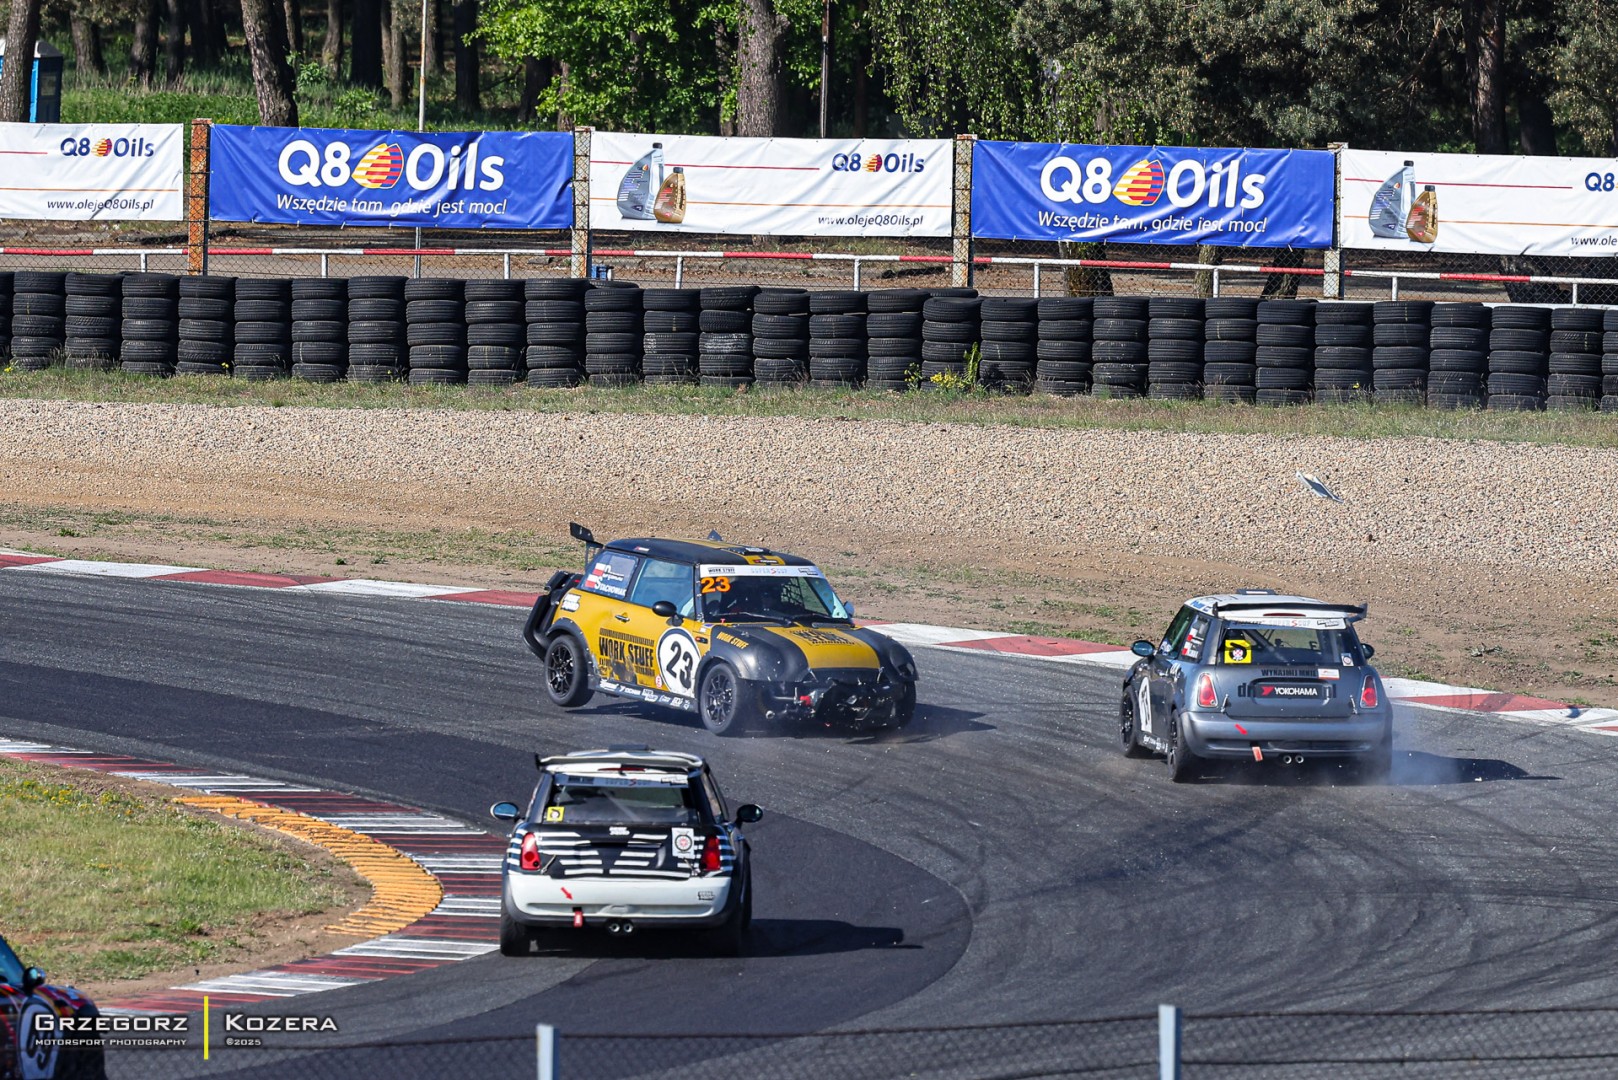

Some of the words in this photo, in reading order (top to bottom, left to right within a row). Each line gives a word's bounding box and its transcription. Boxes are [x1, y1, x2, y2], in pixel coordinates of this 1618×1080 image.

[60, 137, 90, 157] Q8
[113, 137, 155, 157] Oils
[278, 139, 351, 188] Q8
[405, 142, 505, 191] Oils
[832, 153, 862, 172] Q8
[883, 152, 925, 173] Oils
[1039, 156, 1113, 205] Q8
[1166, 159, 1267, 209] Oils
[1584, 172, 1615, 192] Q8
[47, 199, 154, 212] www.olejeQ8Oils.pl
[276, 193, 347, 214] Wszędzie
[351, 198, 387, 214] tam,
[390, 200, 432, 217] gdzie
[433, 198, 464, 217] jest
[468, 199, 507, 214] moc!
[818, 214, 924, 228] www.olejeQ8Oils.pl
[1038, 210, 1109, 231] Wszędzie
[1113, 214, 1148, 233] tam,
[1152, 215, 1193, 233] gdzie
[1197, 216, 1224, 233] jest
[1228, 217, 1268, 233] moc!
[700, 576, 731, 594] 23
[716, 631, 732, 645] WORK
[731, 636, 749, 650] STUFF
[599, 636, 626, 662] WORK
[627, 643, 654, 668] STUFF
[666, 640, 693, 690] 23
[1275, 686, 1318, 696] YOKOHAMA
